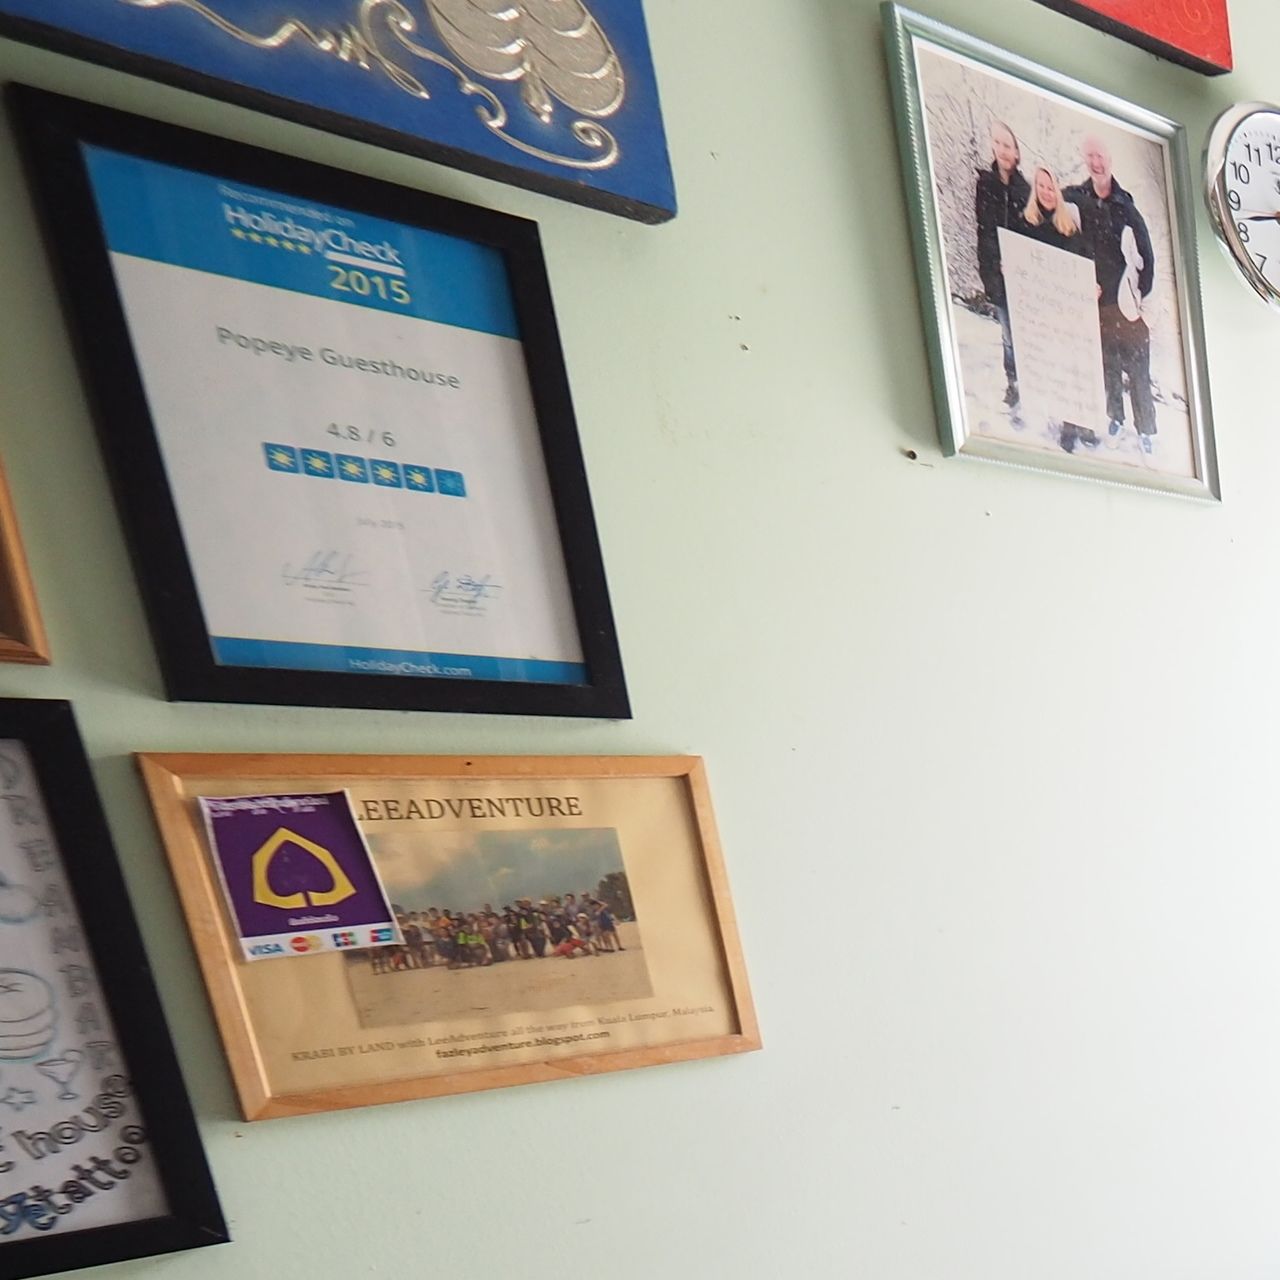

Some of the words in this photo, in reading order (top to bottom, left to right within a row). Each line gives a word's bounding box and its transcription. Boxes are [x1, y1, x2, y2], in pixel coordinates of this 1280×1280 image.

[1244, 143, 1261, 167] 11
[1230, 161, 1250, 185] 10
[1228, 190, 1241, 211] 9
[222, 203, 406, 265] HolidayCheck
[1237, 222, 1250, 243] 8
[1255, 252, 1268, 273] 7
[327, 265, 411, 304] 2015
[216, 326, 313, 362] Popeye
[319, 348, 461, 389] Guesthouse
[326, 422, 361, 443] 4.8
[382, 430, 396, 447] 6
[357, 796, 583, 821] EEADVENTURE
[249, 943, 285, 956] VISA
[291, 1048, 335, 1062] KRABI
[357, 1041, 395, 1054] LAND
